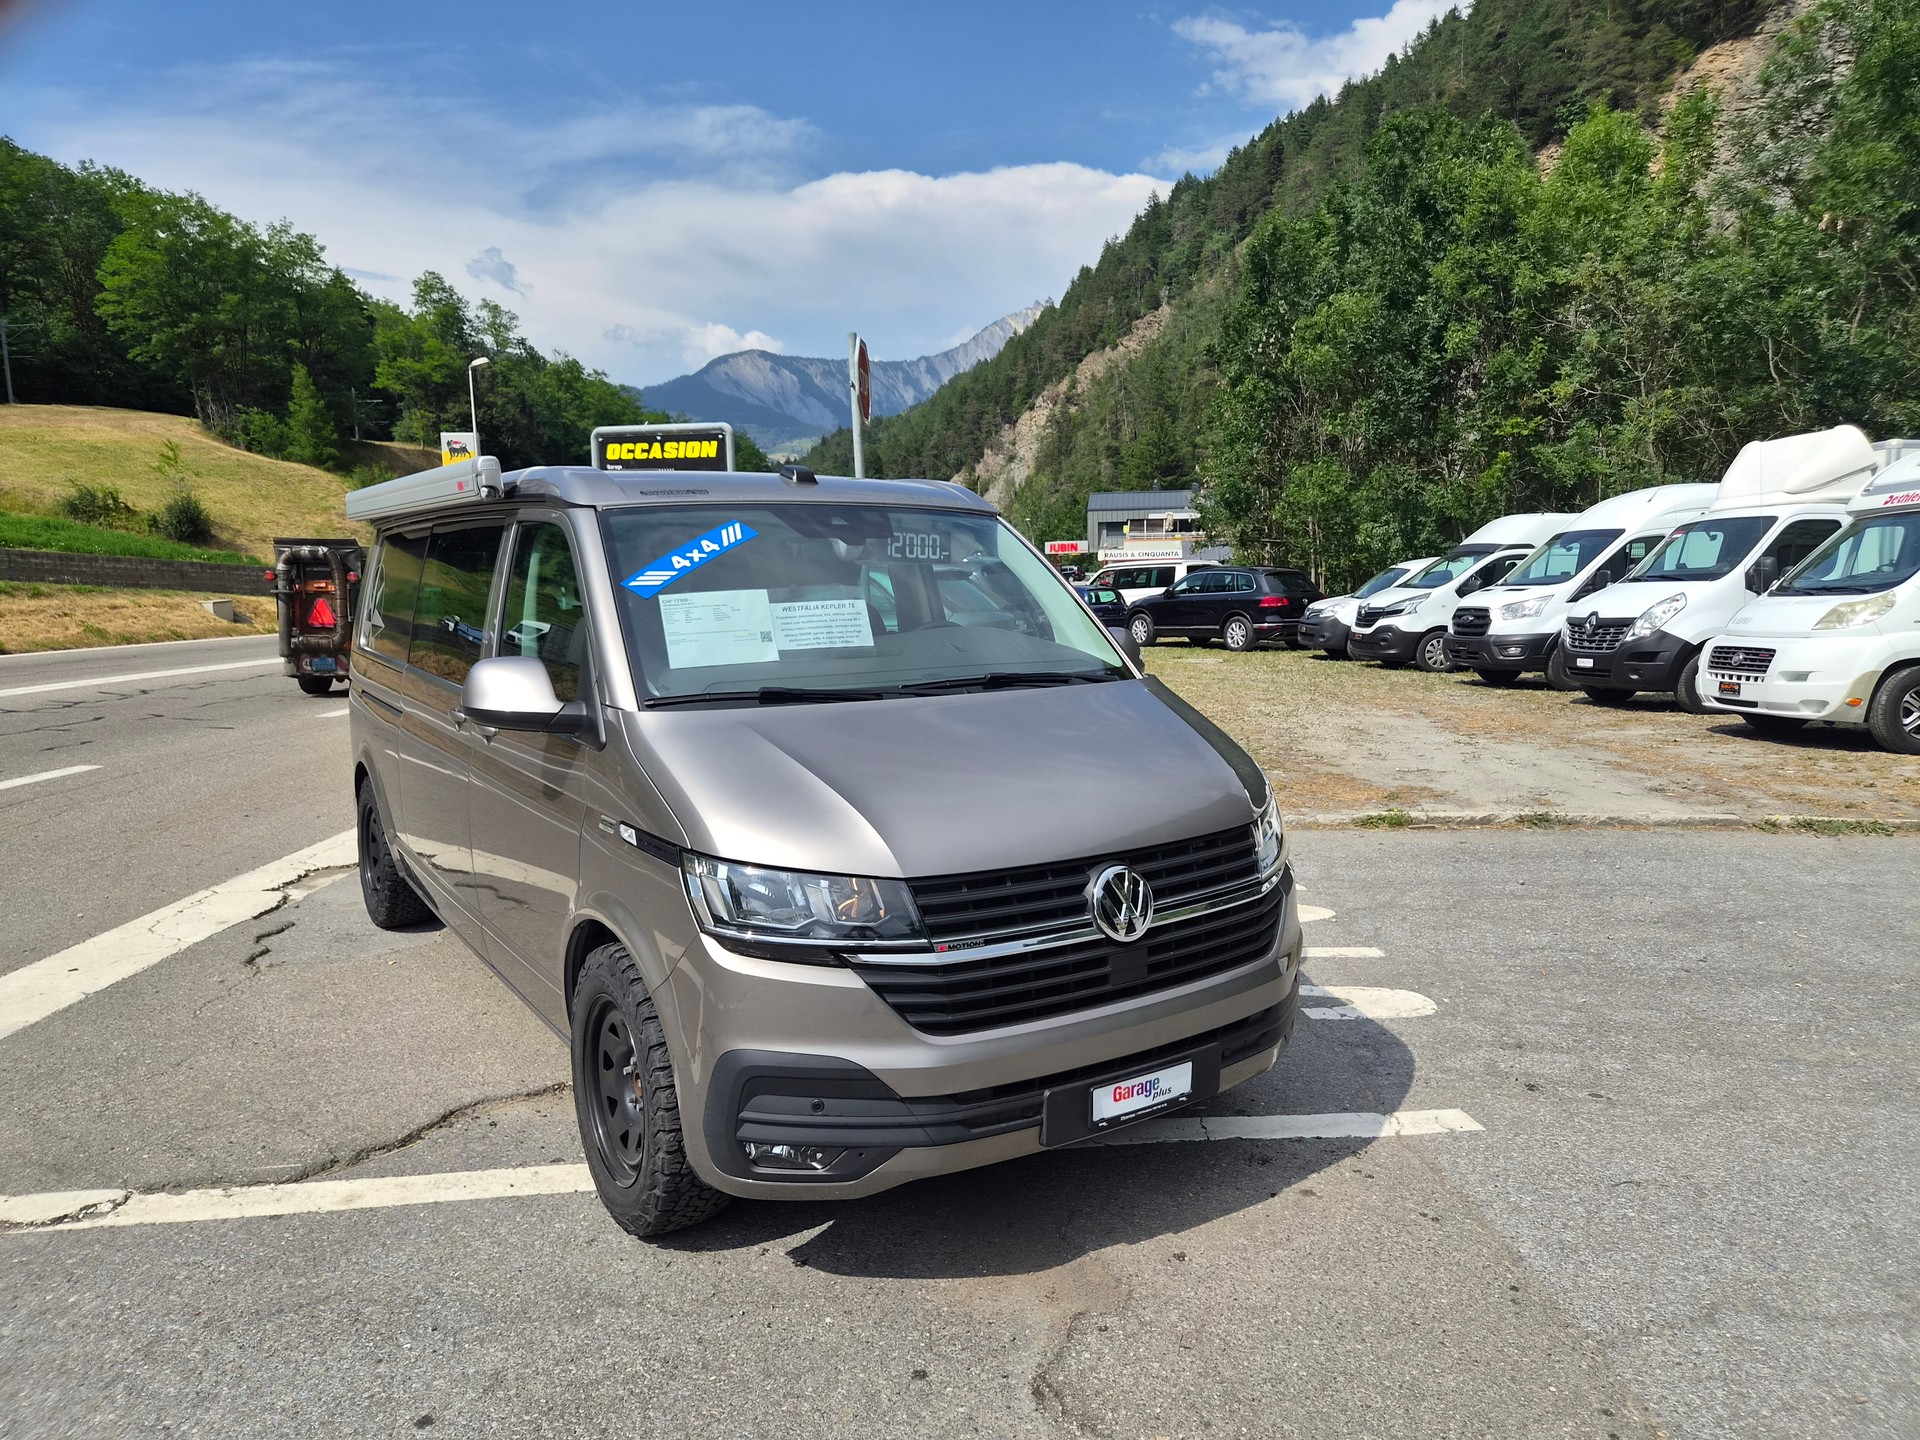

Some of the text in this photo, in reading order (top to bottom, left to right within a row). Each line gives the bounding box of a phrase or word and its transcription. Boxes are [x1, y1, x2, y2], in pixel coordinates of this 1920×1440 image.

[606, 441, 718, 460] OCCASION
[671, 539, 720, 569] 4x4
[1113, 1077, 1160, 1102] Garage
[1152, 1086, 1172, 1101] plus
